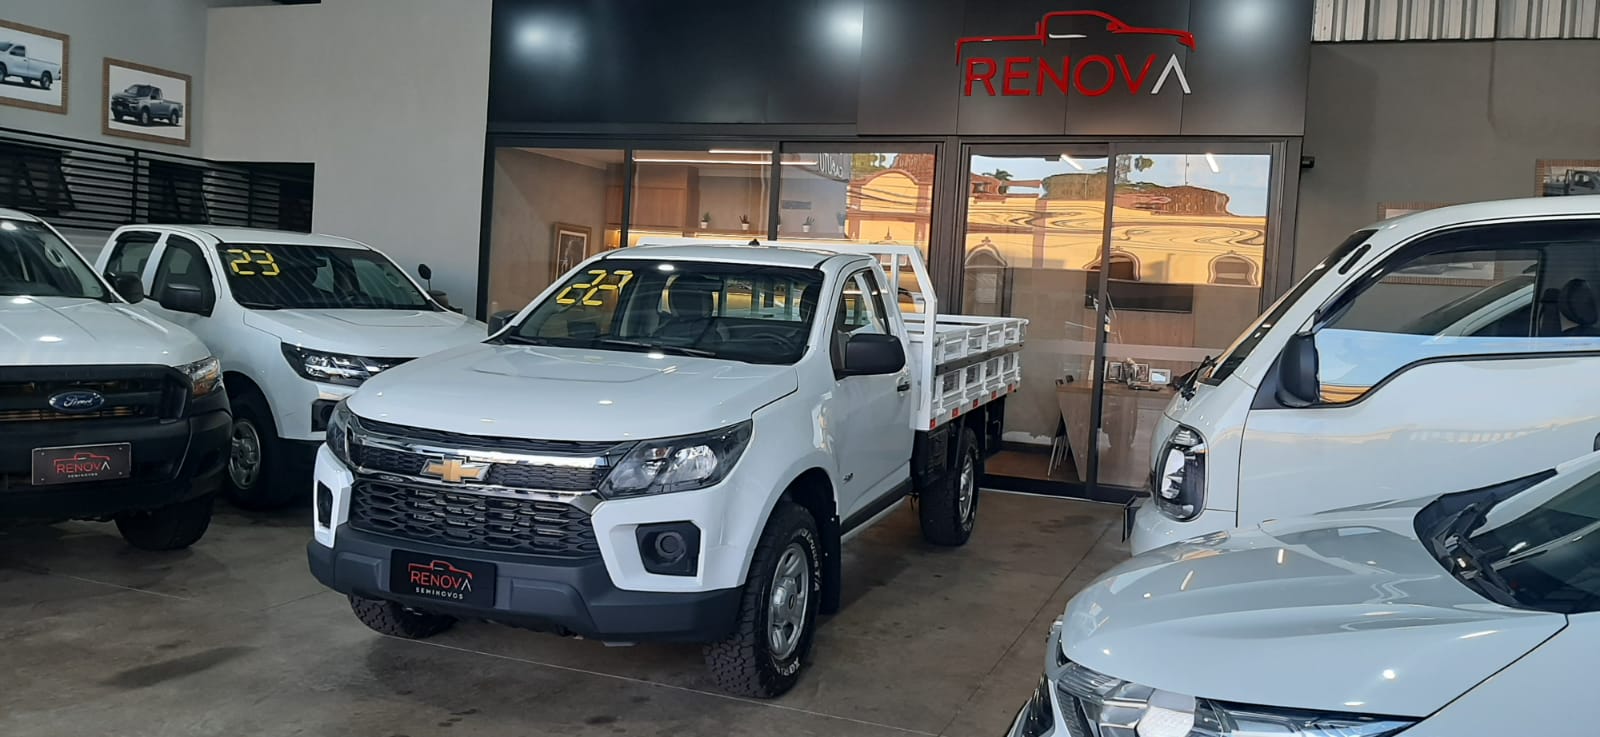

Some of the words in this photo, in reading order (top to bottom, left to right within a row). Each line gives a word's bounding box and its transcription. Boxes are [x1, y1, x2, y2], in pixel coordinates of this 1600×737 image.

[964, 53, 1192, 96] RENOVA
[227, 249, 280, 276] 23
[555, 269, 634, 306] 22
[56, 461, 111, 474] RENOVA
[410, 570, 472, 592] RENOVA
[415, 587, 464, 600] SEMINOVOS
